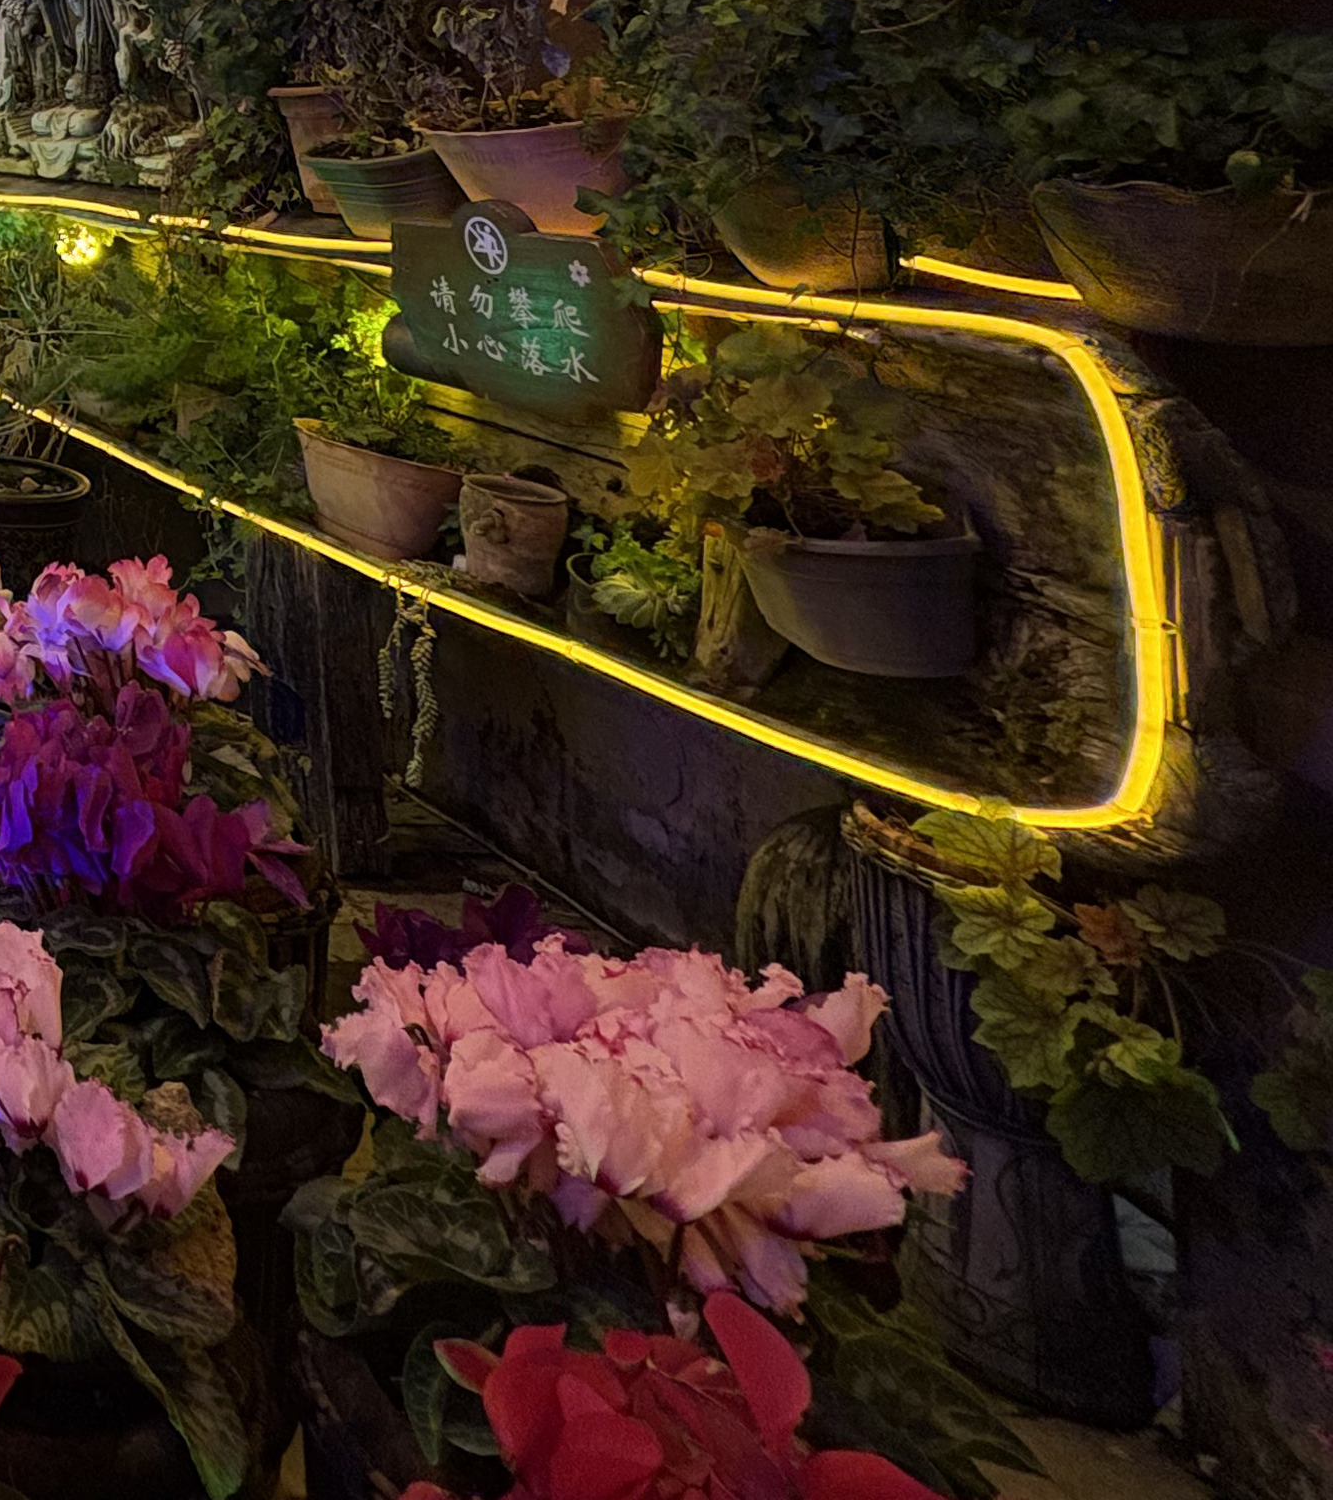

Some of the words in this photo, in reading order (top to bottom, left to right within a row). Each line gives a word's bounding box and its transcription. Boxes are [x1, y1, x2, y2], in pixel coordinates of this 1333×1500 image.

[430, 275, 591, 338] 请勿攀爬
[442, 323, 601, 384] 小心落水
